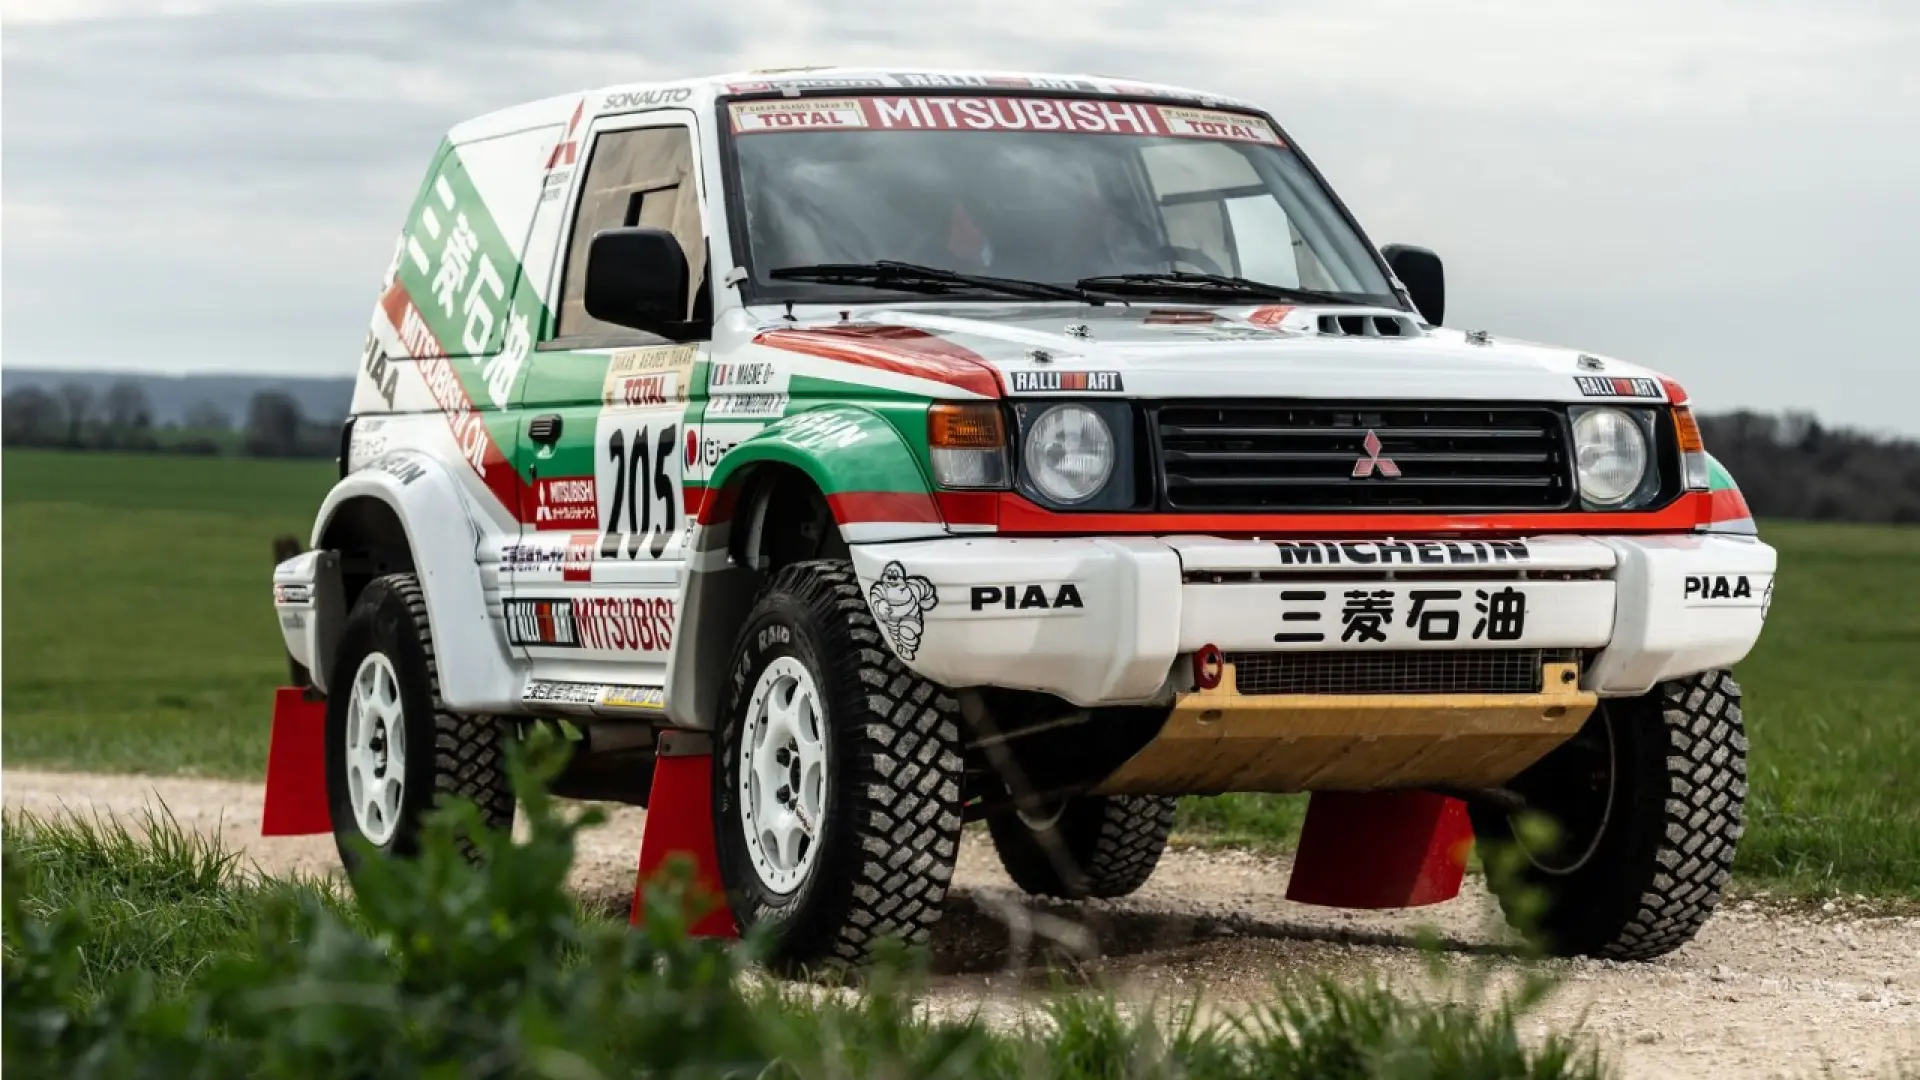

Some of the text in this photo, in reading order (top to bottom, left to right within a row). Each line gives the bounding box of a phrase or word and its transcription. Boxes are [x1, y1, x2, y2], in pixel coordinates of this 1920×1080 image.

[603, 87, 692, 109] SONAUTO
[757, 111, 843, 127] TOTAL
[873, 97, 1159, 134] MITSUBISHI
[1184, 119, 1261, 140] TOTAL
[408, 174, 531, 413] 三菱石油
[365, 329, 399, 411] PIAA
[736, 362, 764, 384] MAGNE
[1016, 372, 1117, 390] RALLI ART
[400, 302, 488, 478] MITSUBISHI OIL
[624, 375, 667, 405] TOTAL
[1577, 378, 1658, 397] RALLI ART
[549, 480, 594, 503] MITSUBISHI
[601, 423, 676, 560] 205
[1274, 541, 1530, 564] MICHELIN
[970, 584, 1084, 611] PIAA
[1684, 575, 1752, 600] PIAA
[572, 597, 675, 651] MITSUBIS
[1274, 585, 1526, 643] 三菱石油
[758, 622, 791, 655] RAID
